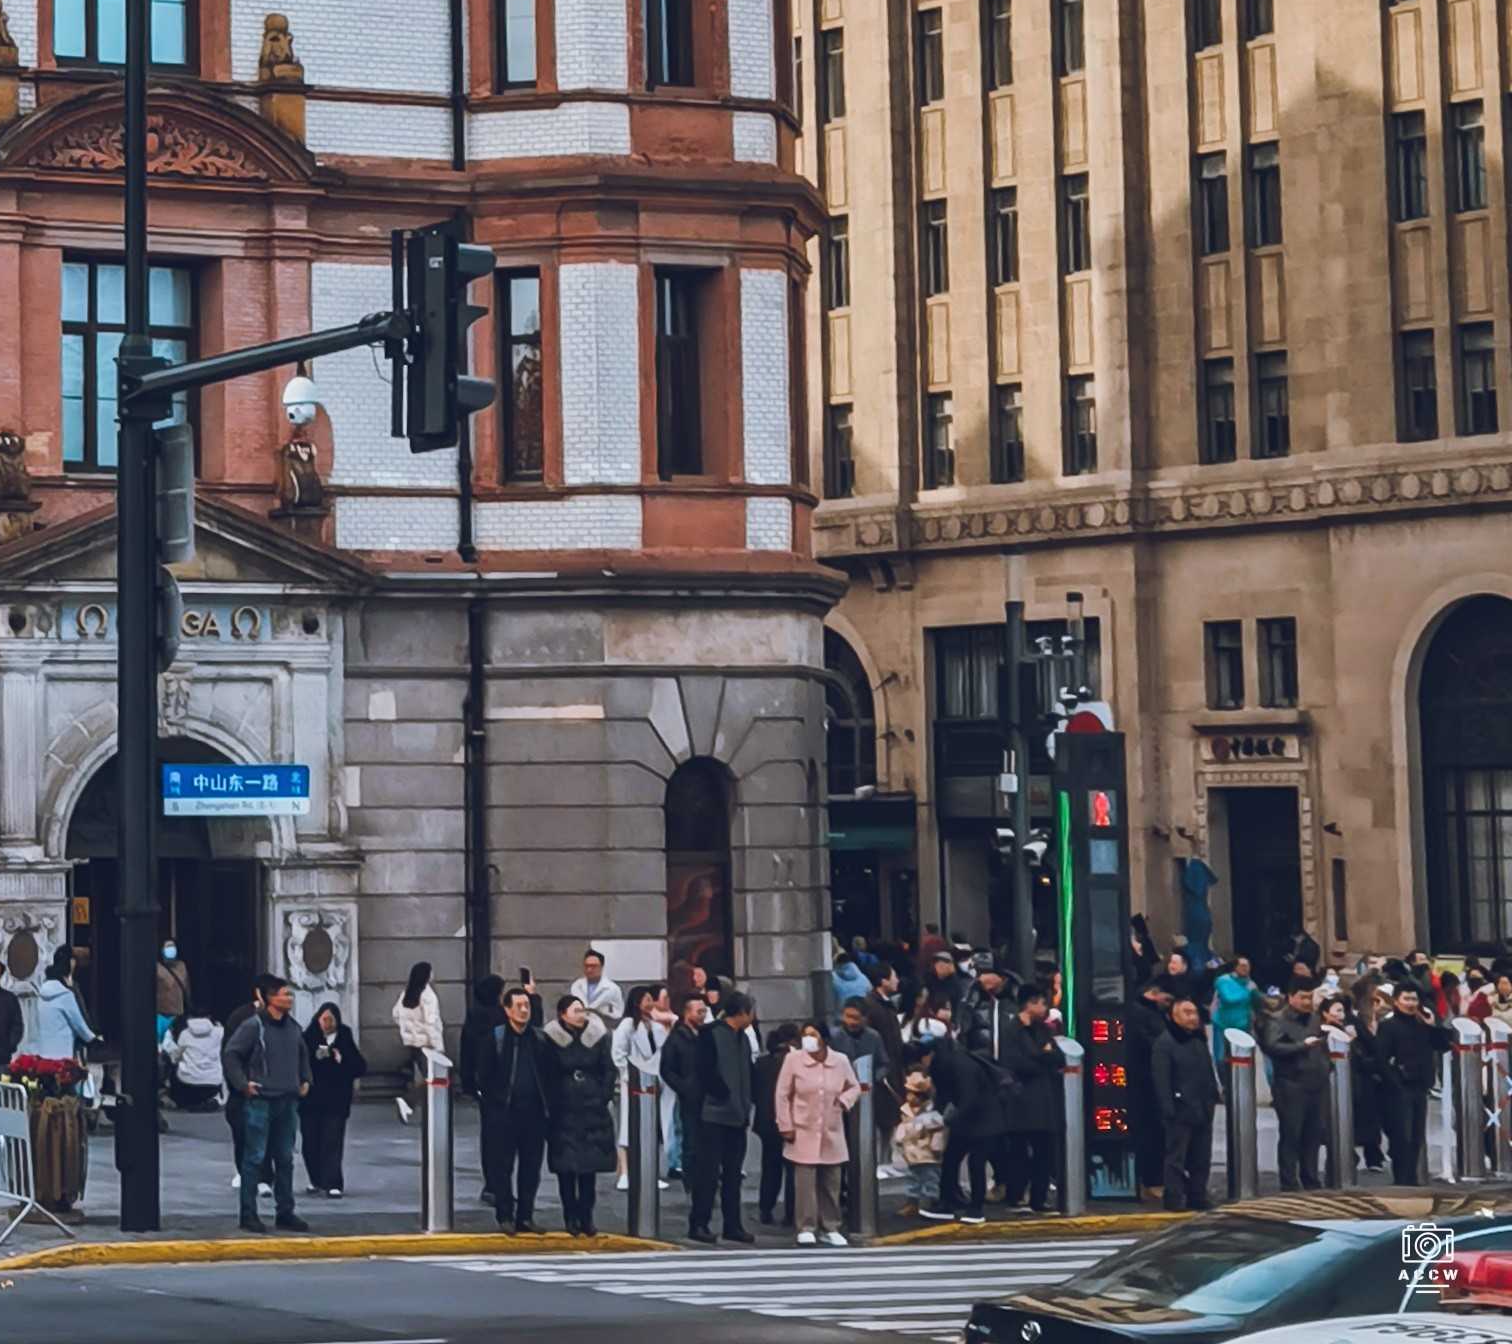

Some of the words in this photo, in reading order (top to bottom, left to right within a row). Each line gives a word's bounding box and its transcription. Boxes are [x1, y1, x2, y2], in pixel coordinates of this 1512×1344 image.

[193, 773, 279, 792] 中山东一路
[292, 801, 301, 811] N
